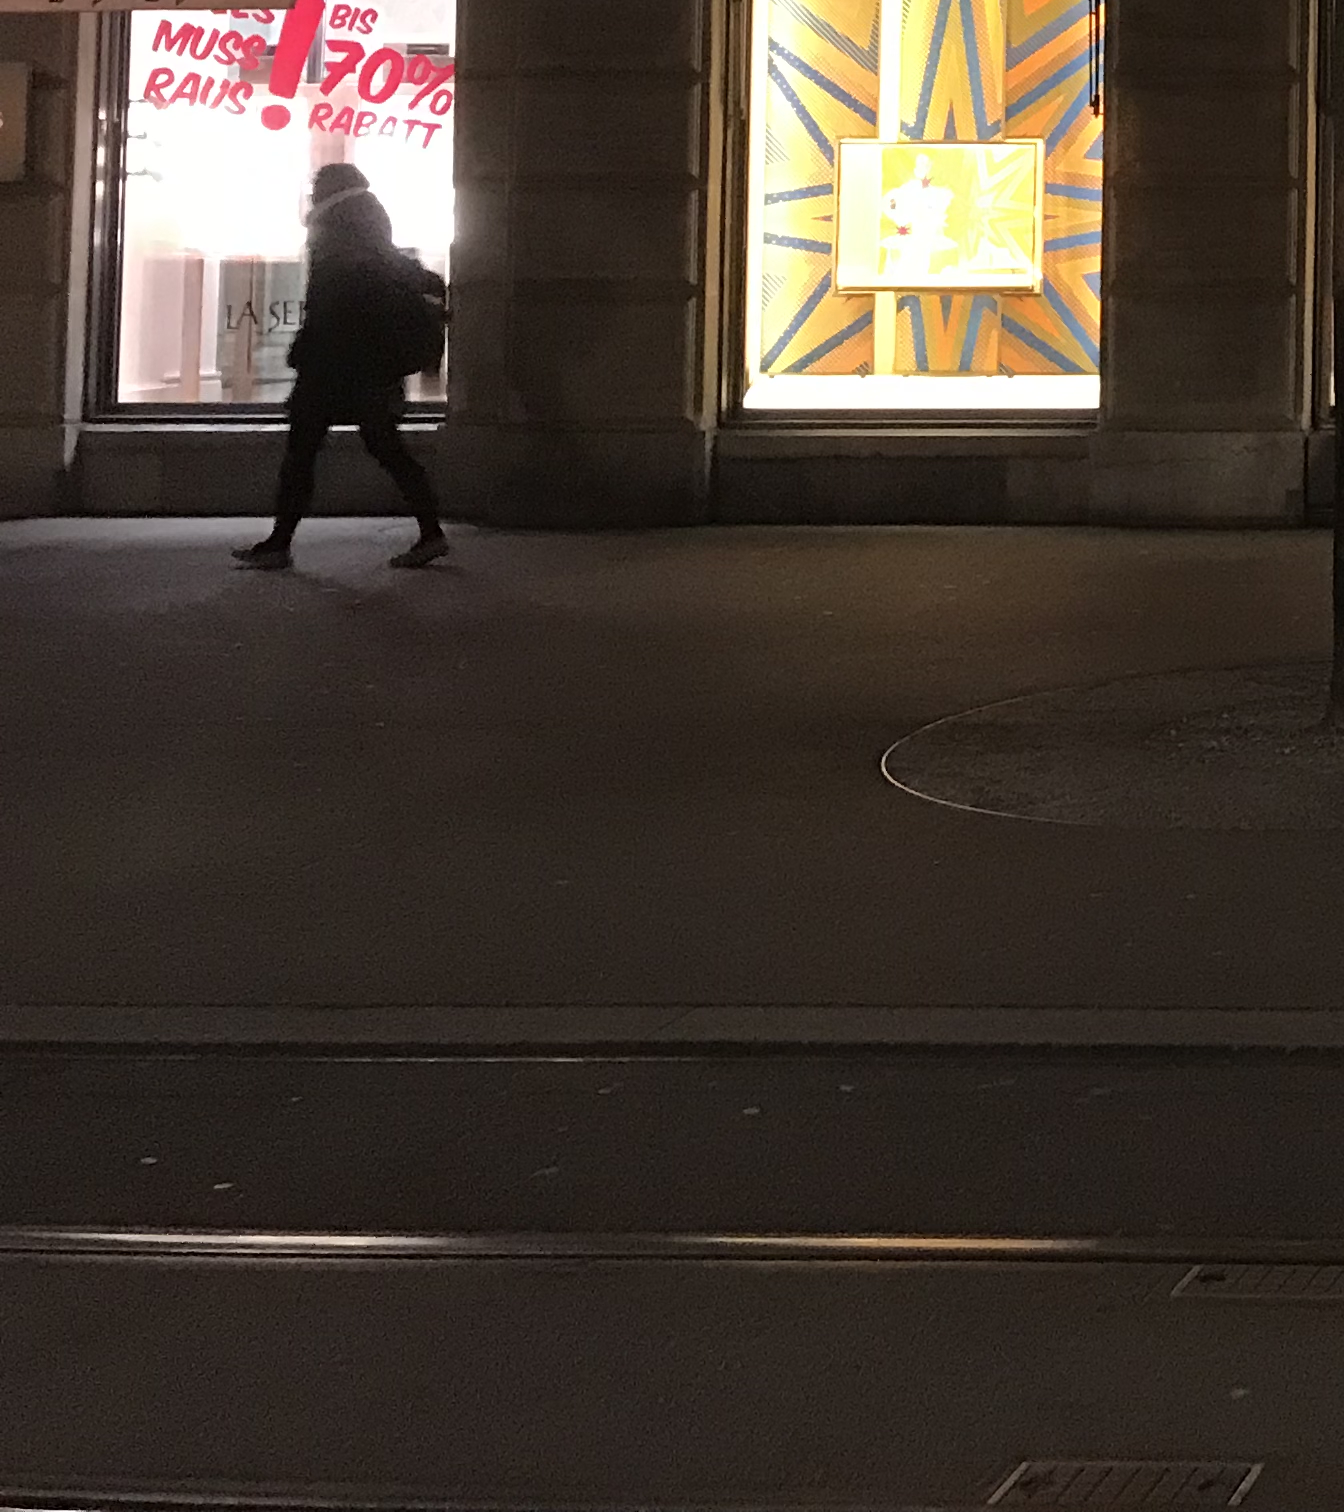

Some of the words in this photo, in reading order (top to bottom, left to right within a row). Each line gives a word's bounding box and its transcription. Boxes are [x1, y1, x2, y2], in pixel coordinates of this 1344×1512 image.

[329, 4, 379, 35] BIS
[151, 19, 267, 71] MUSS
[143, 67, 254, 115] RAUS
[319, 39, 455, 116] 70%
[308, 102, 443, 150] RABATT
[226, 300, 259, 330] LA
